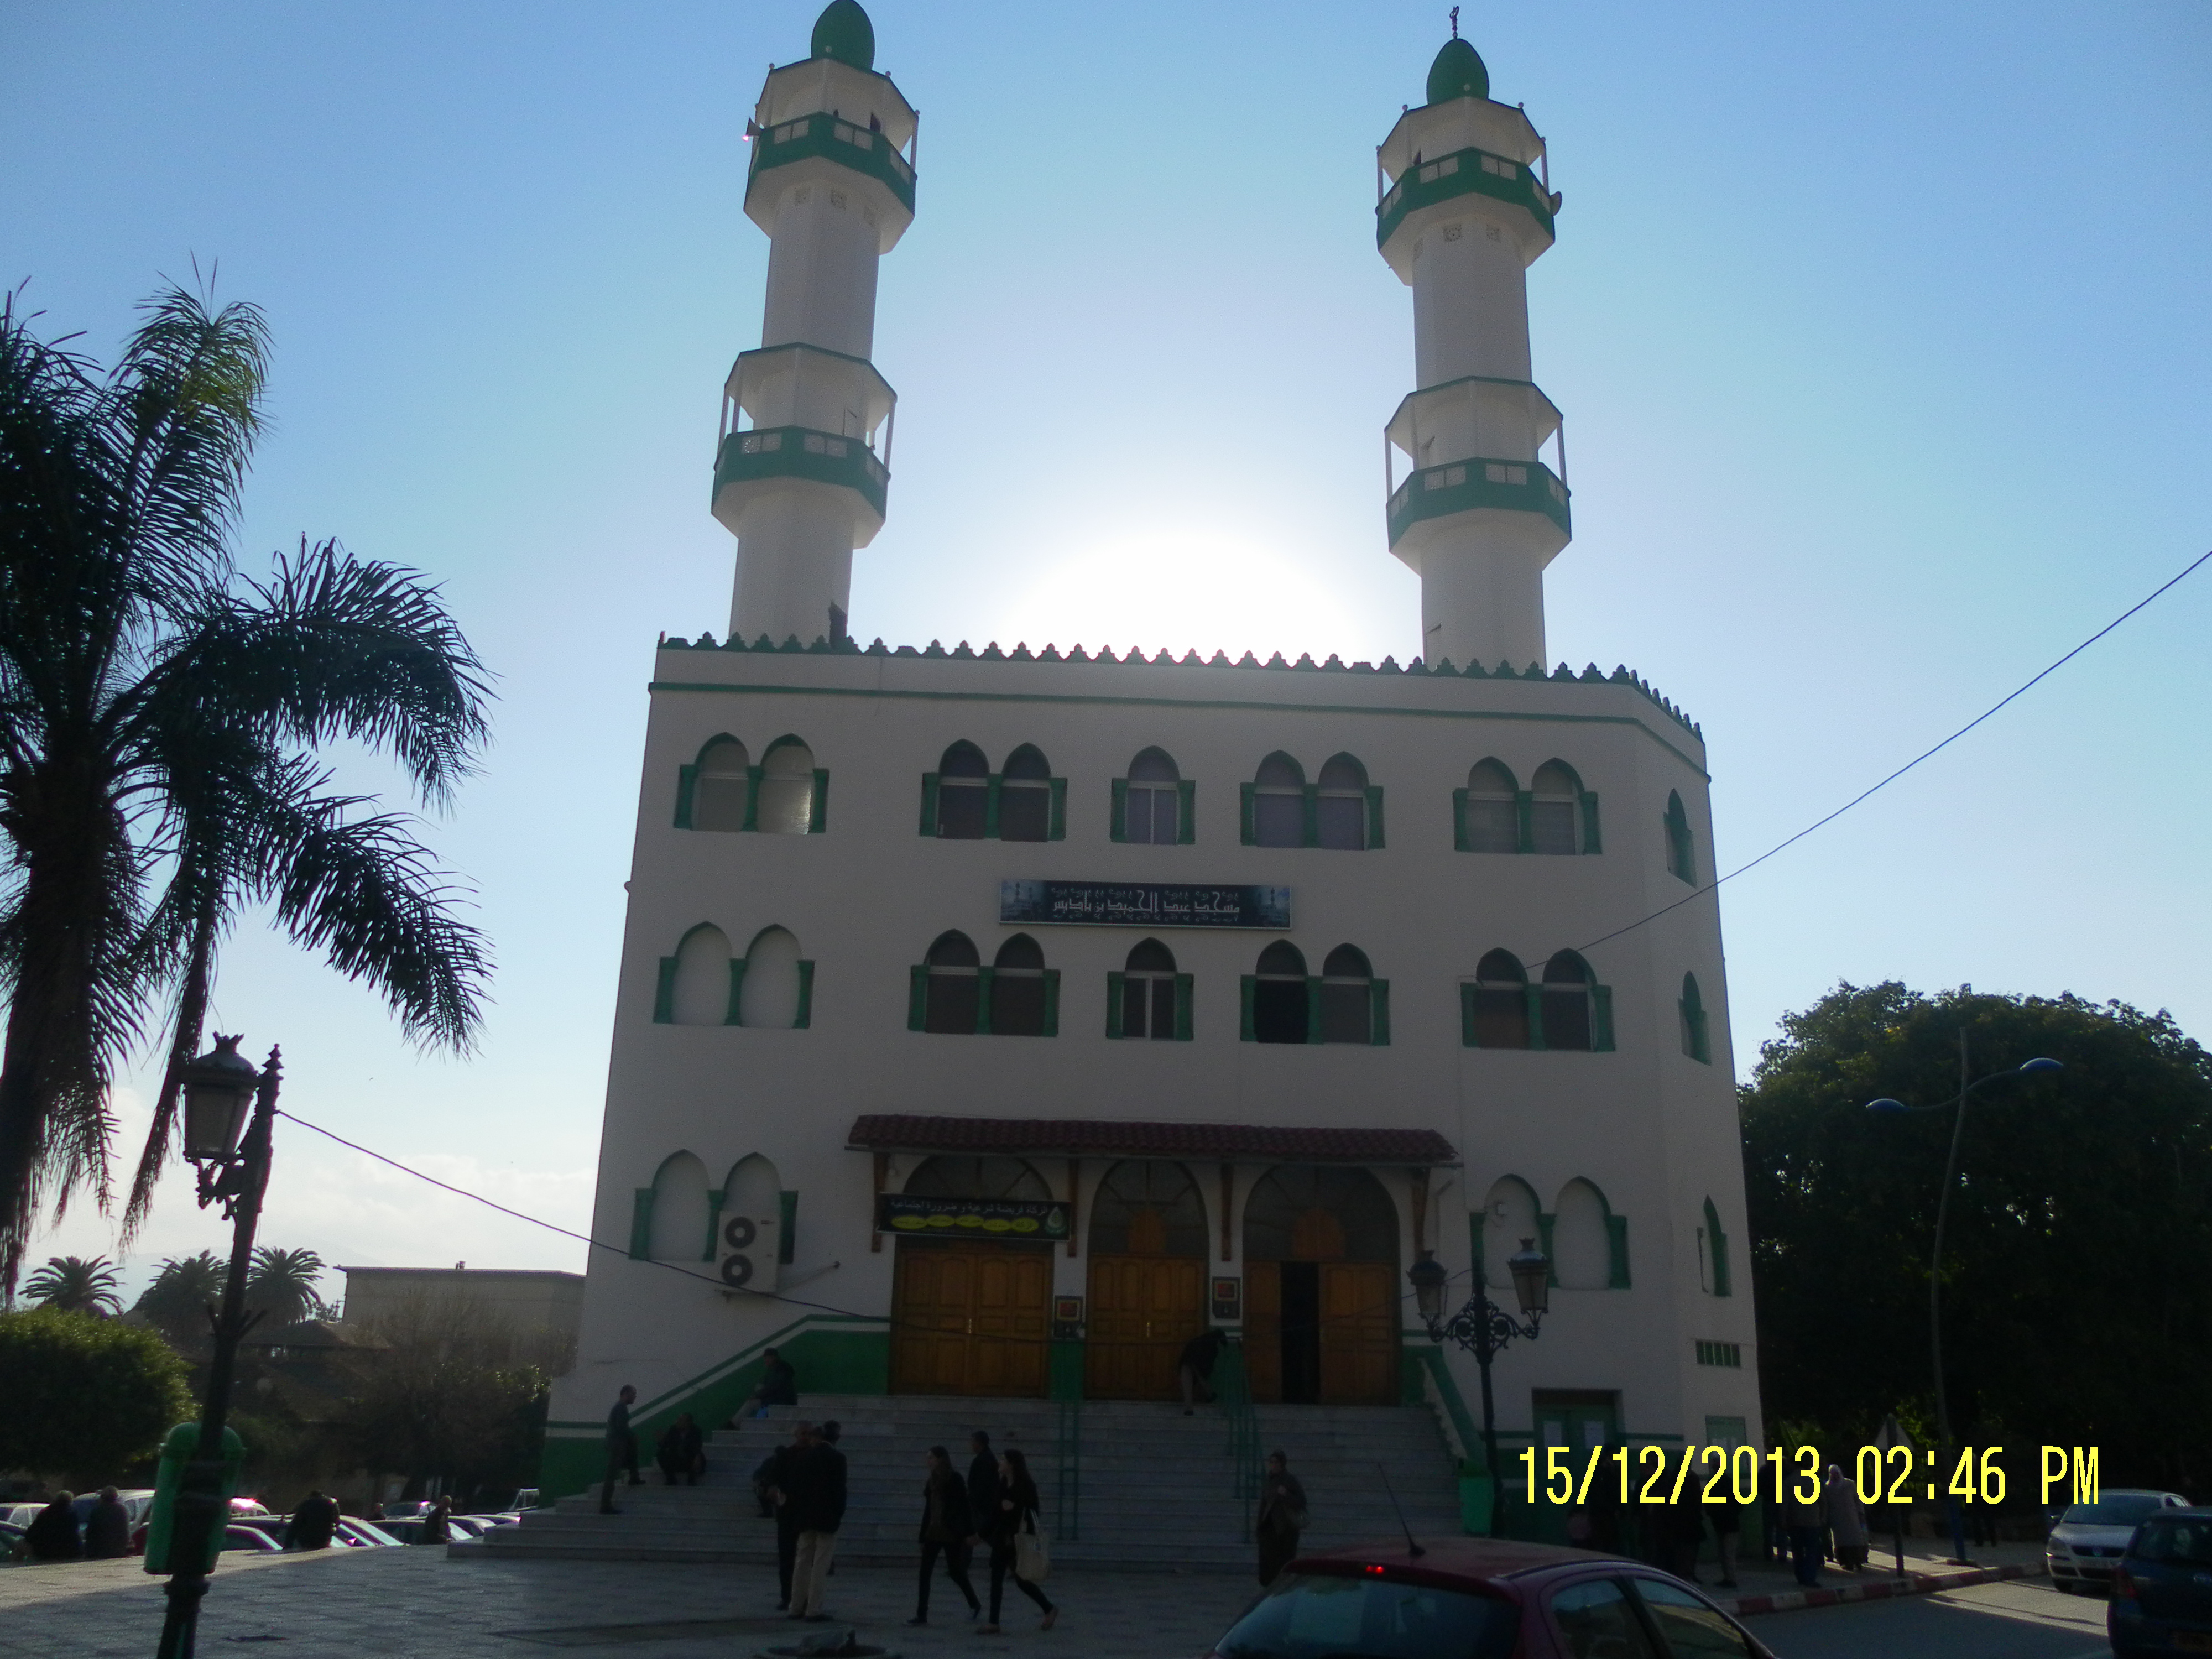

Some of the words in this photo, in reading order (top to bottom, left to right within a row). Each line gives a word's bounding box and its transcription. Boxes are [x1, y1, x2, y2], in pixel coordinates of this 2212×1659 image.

[1052, 890, 1092, 914] باديس
[1095, 901, 1104, 913] بن
[1108, 890, 1159, 915] الحميد
[1164, 900, 1191, 914] عبد
[1194, 891, 1240, 915] مسجد
[926, 1202, 957, 1212] ضرورة
[968, 1202, 993, 1214] شرعية
[996, 1204, 1023, 1215] فريضة
[1026, 1205, 1048, 1216] الزكاة
